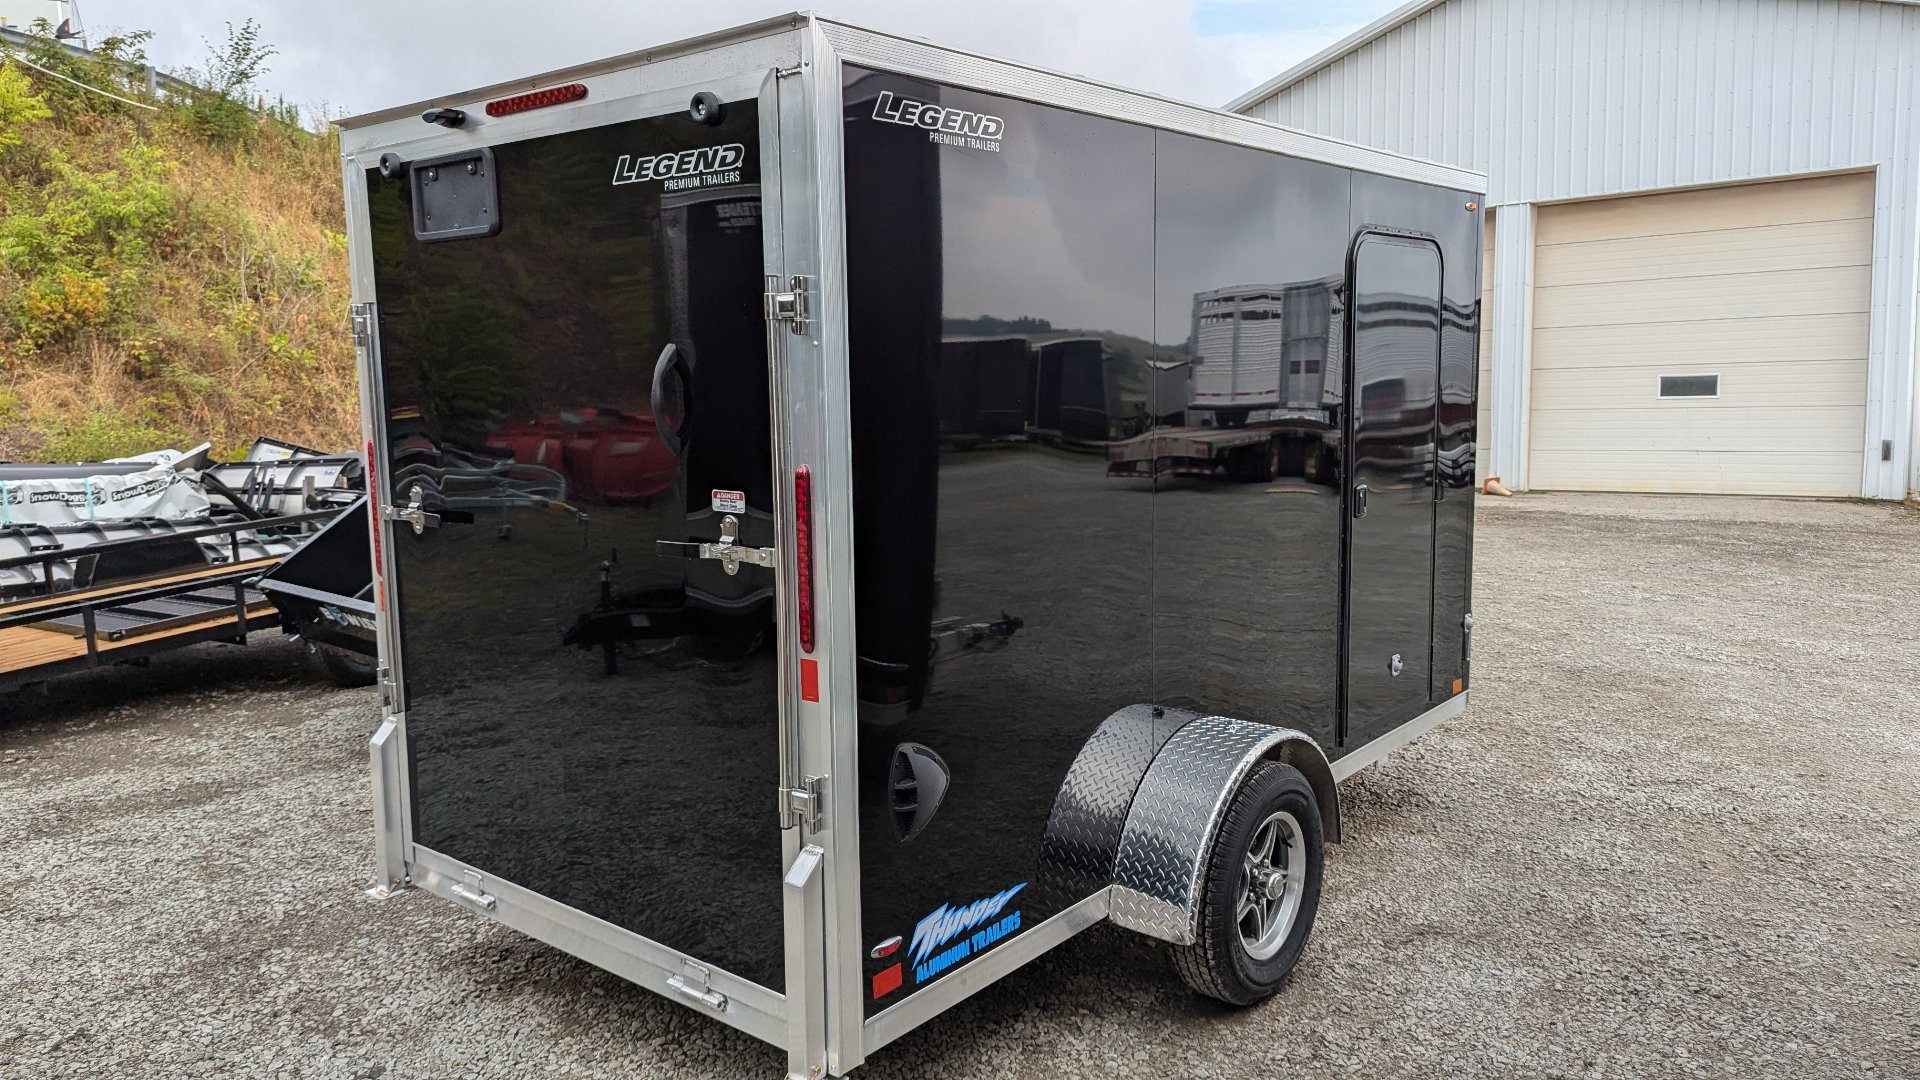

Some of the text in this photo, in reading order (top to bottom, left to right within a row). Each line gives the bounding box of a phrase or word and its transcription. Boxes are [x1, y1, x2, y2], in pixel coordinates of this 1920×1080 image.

[872, 91, 1005, 139] LEGEND
[612, 143, 745, 185] LEGEND
[929, 132, 1000, 152] PREMIUM TRAILERS
[664, 171, 740, 191] PREMIUM TRAILERS
[907, 882, 1028, 971] THUNDER
[916, 911, 1021, 984] ALUMINUM TRAILERS
